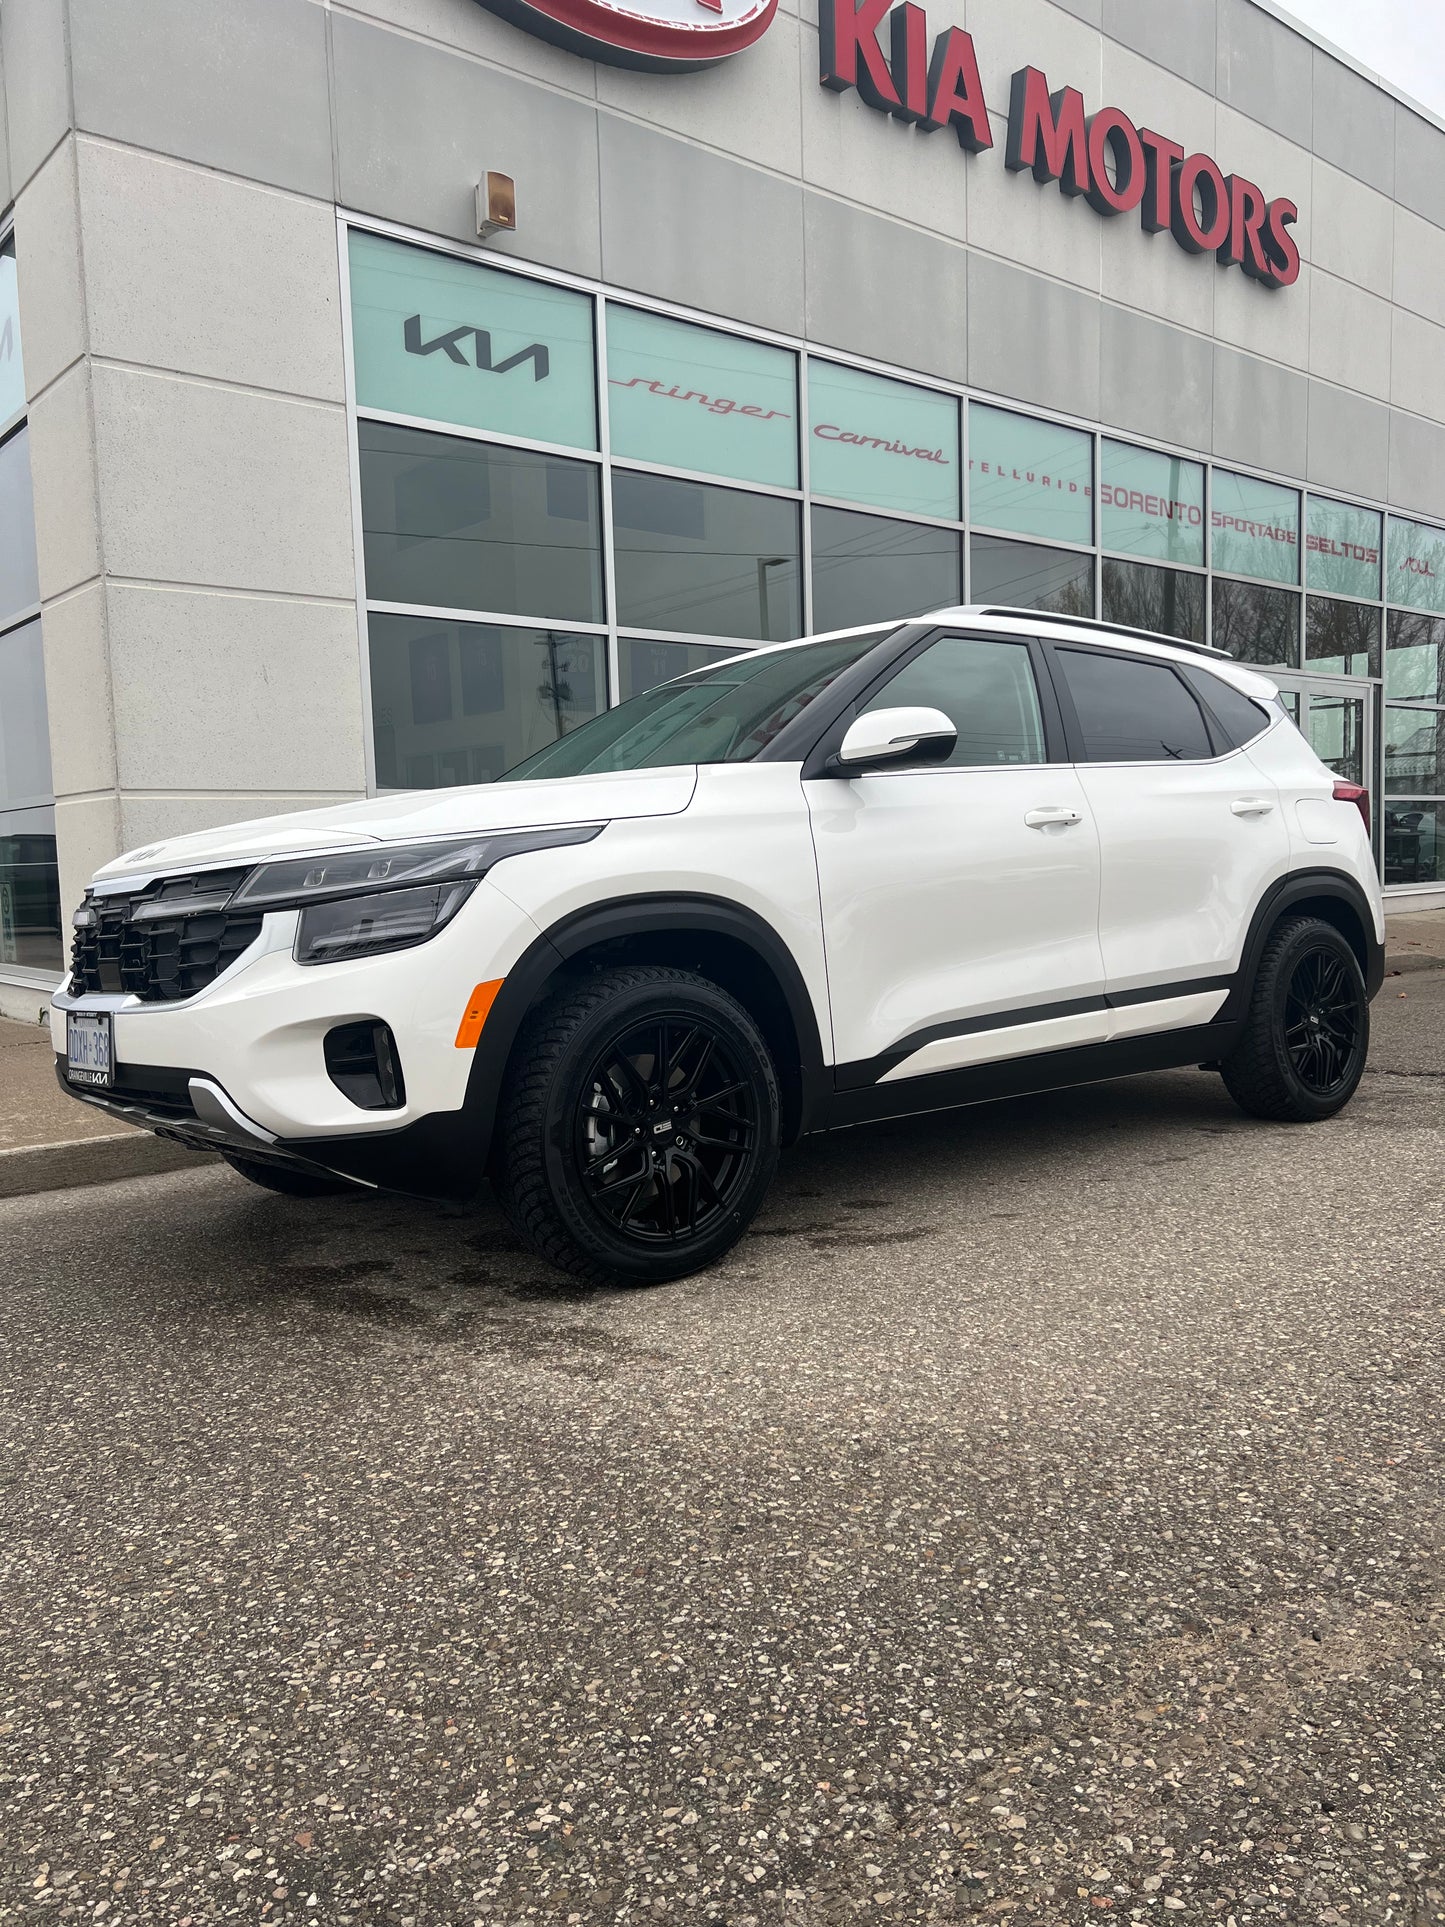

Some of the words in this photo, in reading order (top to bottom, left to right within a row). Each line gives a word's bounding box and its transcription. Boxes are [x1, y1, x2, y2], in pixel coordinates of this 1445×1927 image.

[819, 0, 994, 153] KIA
[1005, 65, 1301, 289] MOTORS
[403, 314, 549, 382] KIA
[812, 423, 950, 466] Carnival
[968, 459, 1091, 497] TELLURIDE
[1100, 484, 1202, 526] SORENTO
[1211, 510, 1297, 545] SPORTAGE
[1306, 533, 1380, 565] SELTOS
